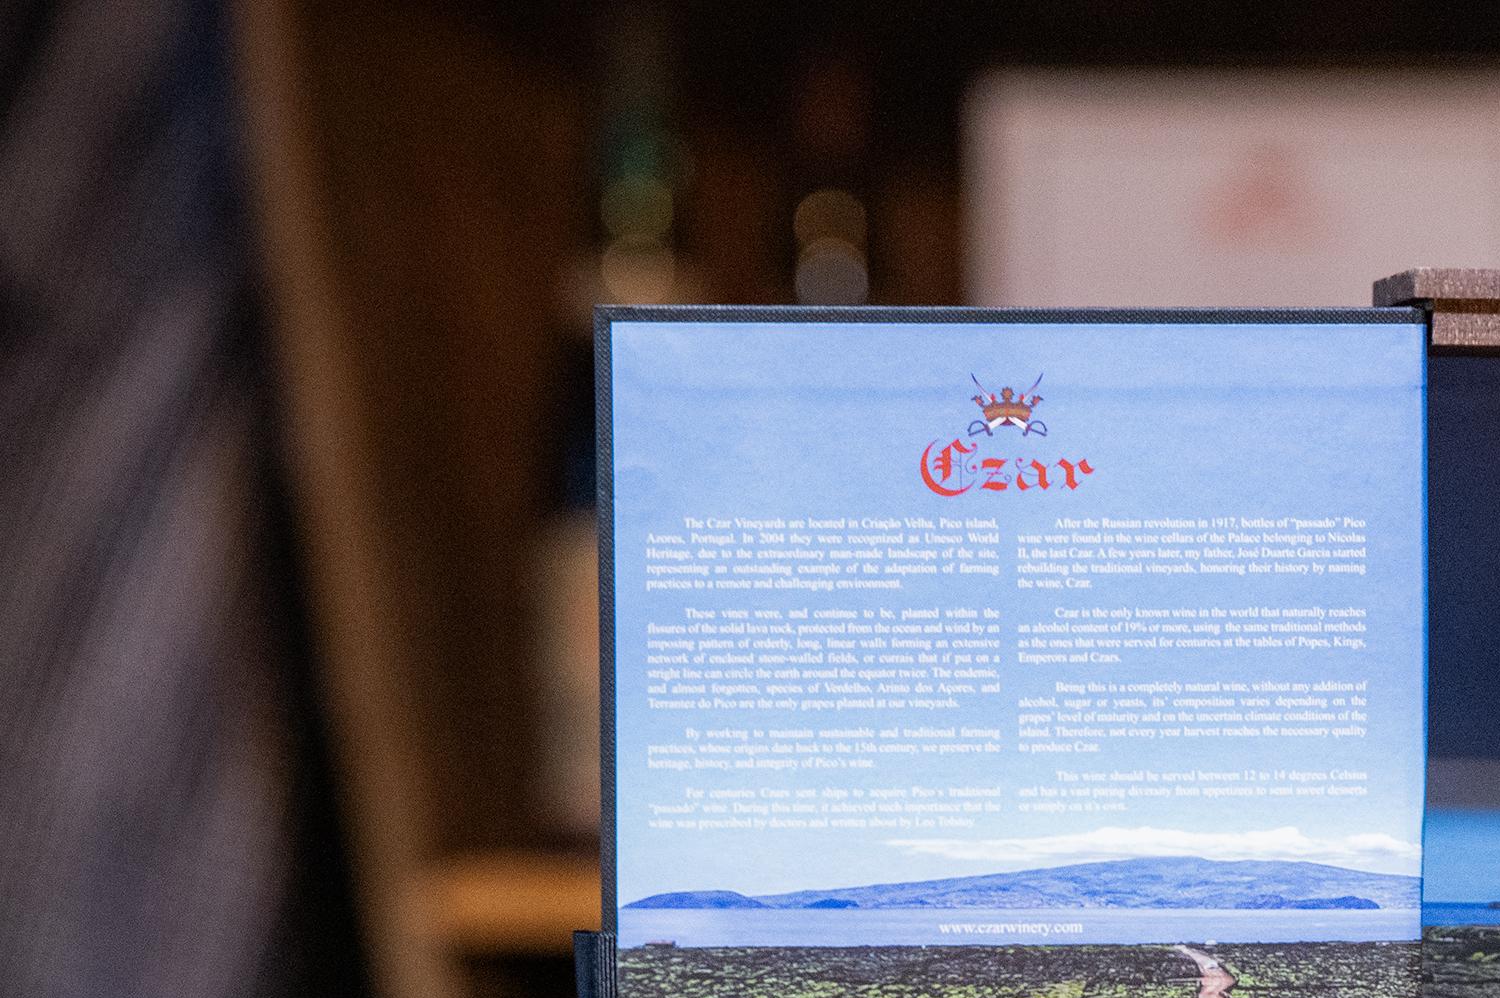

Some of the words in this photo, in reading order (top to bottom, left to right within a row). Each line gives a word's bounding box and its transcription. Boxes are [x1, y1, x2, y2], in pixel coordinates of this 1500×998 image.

[920, 438, 1095, 497] Czar
[684, 518, 704, 528] The
[706, 518, 732, 528] Czar
[735, 518, 786, 531] Vineyards
[808, 518, 846, 528] located
[848, 518, 859, 528] in
[940, 518, 963, 528] Pico
[1055, 517, 1082, 528] After
[1083, 517, 1100, 528] the
[1102, 517, 1142, 528] Russian
[1144, 517, 1196, 528] revolution
[1198, 517, 1208, 528] in
[1241, 517, 1276, 528] bottles
[1276, 517, 1289, 528] of
[1343, 517, 1366, 528] Pico
[743, 533, 754, 544] In
[760, 533, 785, 544] 2004
[790, 533, 812, 546] they
[818, 536, 842, 544] were
[848, 533, 904, 546] recognized
[908, 536, 920, 544] as
[925, 533, 963, 544] Unesco
[968, 533, 1000, 544] World
[1018, 532, 1043, 543] wine
[1044, 535, 1070, 543] were
[1072, 532, 1102, 543] found
[1104, 532, 1114, 543] in
[1116, 532, 1132, 543] the
[1135, 532, 1159, 543] wine
[1161, 532, 1194, 543] cellars
[1196, 532, 1208, 543] of
[1210, 532, 1225, 543] the
[1228, 532, 1261, 543] Palace
[1263, 532, 1313, 546] belonging
[1315, 533, 1326, 543] to
[1328, 532, 1366, 543] Nicolas
[698, 548, 717, 558] due
[722, 549, 732, 558] to
[736, 548, 752, 558] the
[758, 548, 824, 561] extraordinary
[830, 548, 883, 558] man-made
[888, 548, 938, 561] landscape
[942, 548, 954, 558] of
[957, 548, 974, 558] the
[1031, 547, 1048, 558] the
[1049, 547, 1067, 558] last
[1098, 547, 1106, 558] A
[1108, 547, 1127, 558] few
[1130, 550, 1156, 561] years
[1185, 550, 1201, 561] my
[1261, 547, 1296, 558] Duarte
[1333, 547, 1367, 558] started
[646, 563, 709, 576] representing
[715, 566, 727, 574] an
[733, 563, 792, 576] outstanding
[798, 563, 841, 576] example
[846, 563, 858, 574] of
[863, 563, 879, 574] the
[885, 563, 938, 576] adaptation
[942, 563, 956, 574] of
[959, 563, 1000, 576] farming
[1017, 562, 1069, 576] rebuilding
[1072, 562, 1088, 573] the
[1091, 562, 1143, 573] traditional
[1200, 562, 1246, 576] honoring
[1248, 562, 1272, 573] their
[1274, 562, 1309, 576] history
[1312, 562, 1325, 576] by
[1328, 562, 1367, 576] naming
[1018, 577, 1034, 588] the
[1055, 607, 1079, 617] Czar
[1082, 607, 1090, 617] is
[1092, 607, 1109, 617] the
[1110, 607, 1132, 620] only
[1135, 607, 1170, 617] known
[1172, 607, 1197, 617] wine
[1199, 607, 1210, 617] in
[1211, 607, 1227, 617] the
[1230, 607, 1260, 617] world
[1260, 607, 1281, 617] that
[1282, 607, 1326, 620] naturally
[1328, 607, 1367, 617] reaches
[1018, 624, 1031, 632] an
[1032, 622, 1070, 632] alcohol
[1071, 623, 1109, 632] content
[1110, 622, 1123, 632] of
[1125, 622, 1147, 632] 19%
[1148, 624, 1160, 632] or
[1193, 622, 1221, 635] using
[1225, 622, 1242, 632] the
[1243, 624, 1270, 632] same
[1270, 622, 1323, 632] traditional
[1324, 622, 1367, 632] methods
[1018, 639, 1030, 647] as
[1031, 636, 1047, 647] the
[1049, 639, 1073, 647] ones
[1075, 636, 1095, 647] that
[1097, 639, 1121, 647] were
[1124, 636, 1157, 647] served
[1159, 636, 1174, 647] for
[1176, 636, 1222, 647] centuries
[1223, 637, 1233, 647] at
[1235, 636, 1251, 647] the
[1253, 636, 1283, 647] tables
[1284, 636, 1297, 647] of
[1018, 652, 1068, 665] Emperors
[1069, 652, 1089, 662] and
[938, 921, 1083, 936] www.czarwinery.com
